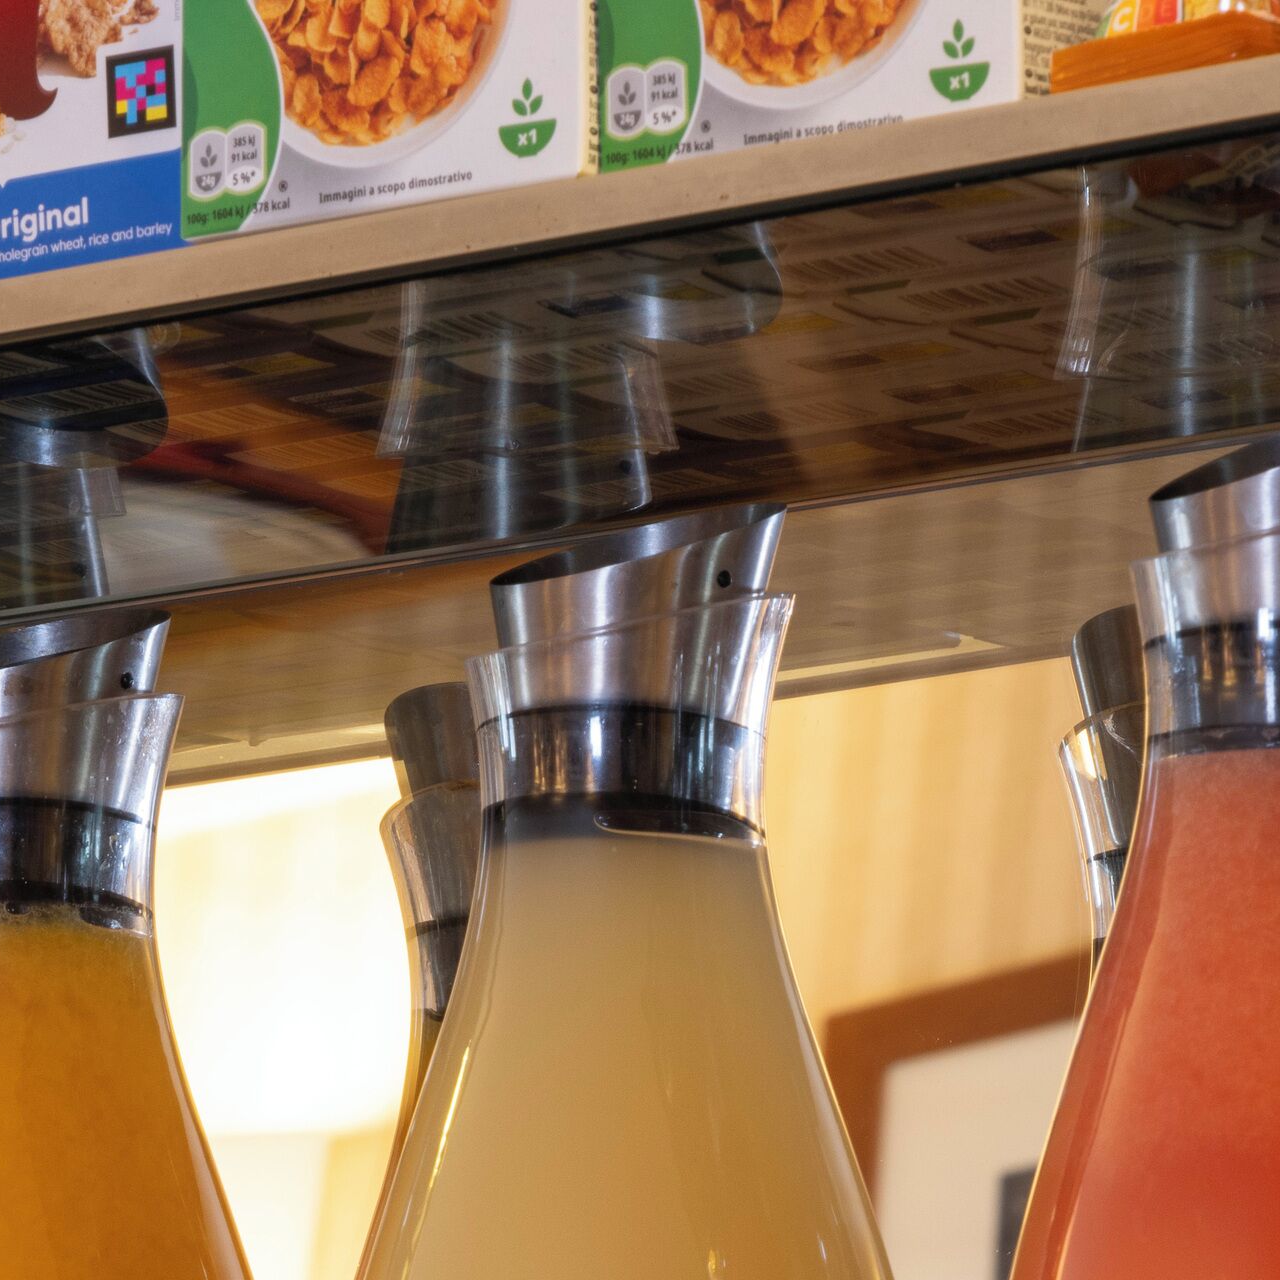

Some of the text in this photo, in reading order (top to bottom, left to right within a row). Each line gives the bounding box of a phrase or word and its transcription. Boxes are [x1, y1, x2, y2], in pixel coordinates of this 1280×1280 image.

[653, 74, 666, 86] 385
[949, 72, 970, 91] x1
[651, 88, 678, 102] 91 kcal
[517, 129, 538, 147] x1
[743, 127, 793, 146] Immagini
[796, 129, 802, 138] a
[804, 122, 835, 138] scopo
[234, 136, 247, 148] 385
[694, 138, 714, 151] kcal
[231, 150, 257, 163] 91 kcal
[319, 170, 473, 204] Immagini a scopo dimostrativo
[271, 197, 291, 210] kcal
[50, 234, 87, 253] wheat,
[88, 230, 109, 247] rice
[111, 225, 134, 243] and
[136, 221, 173, 239] barley
